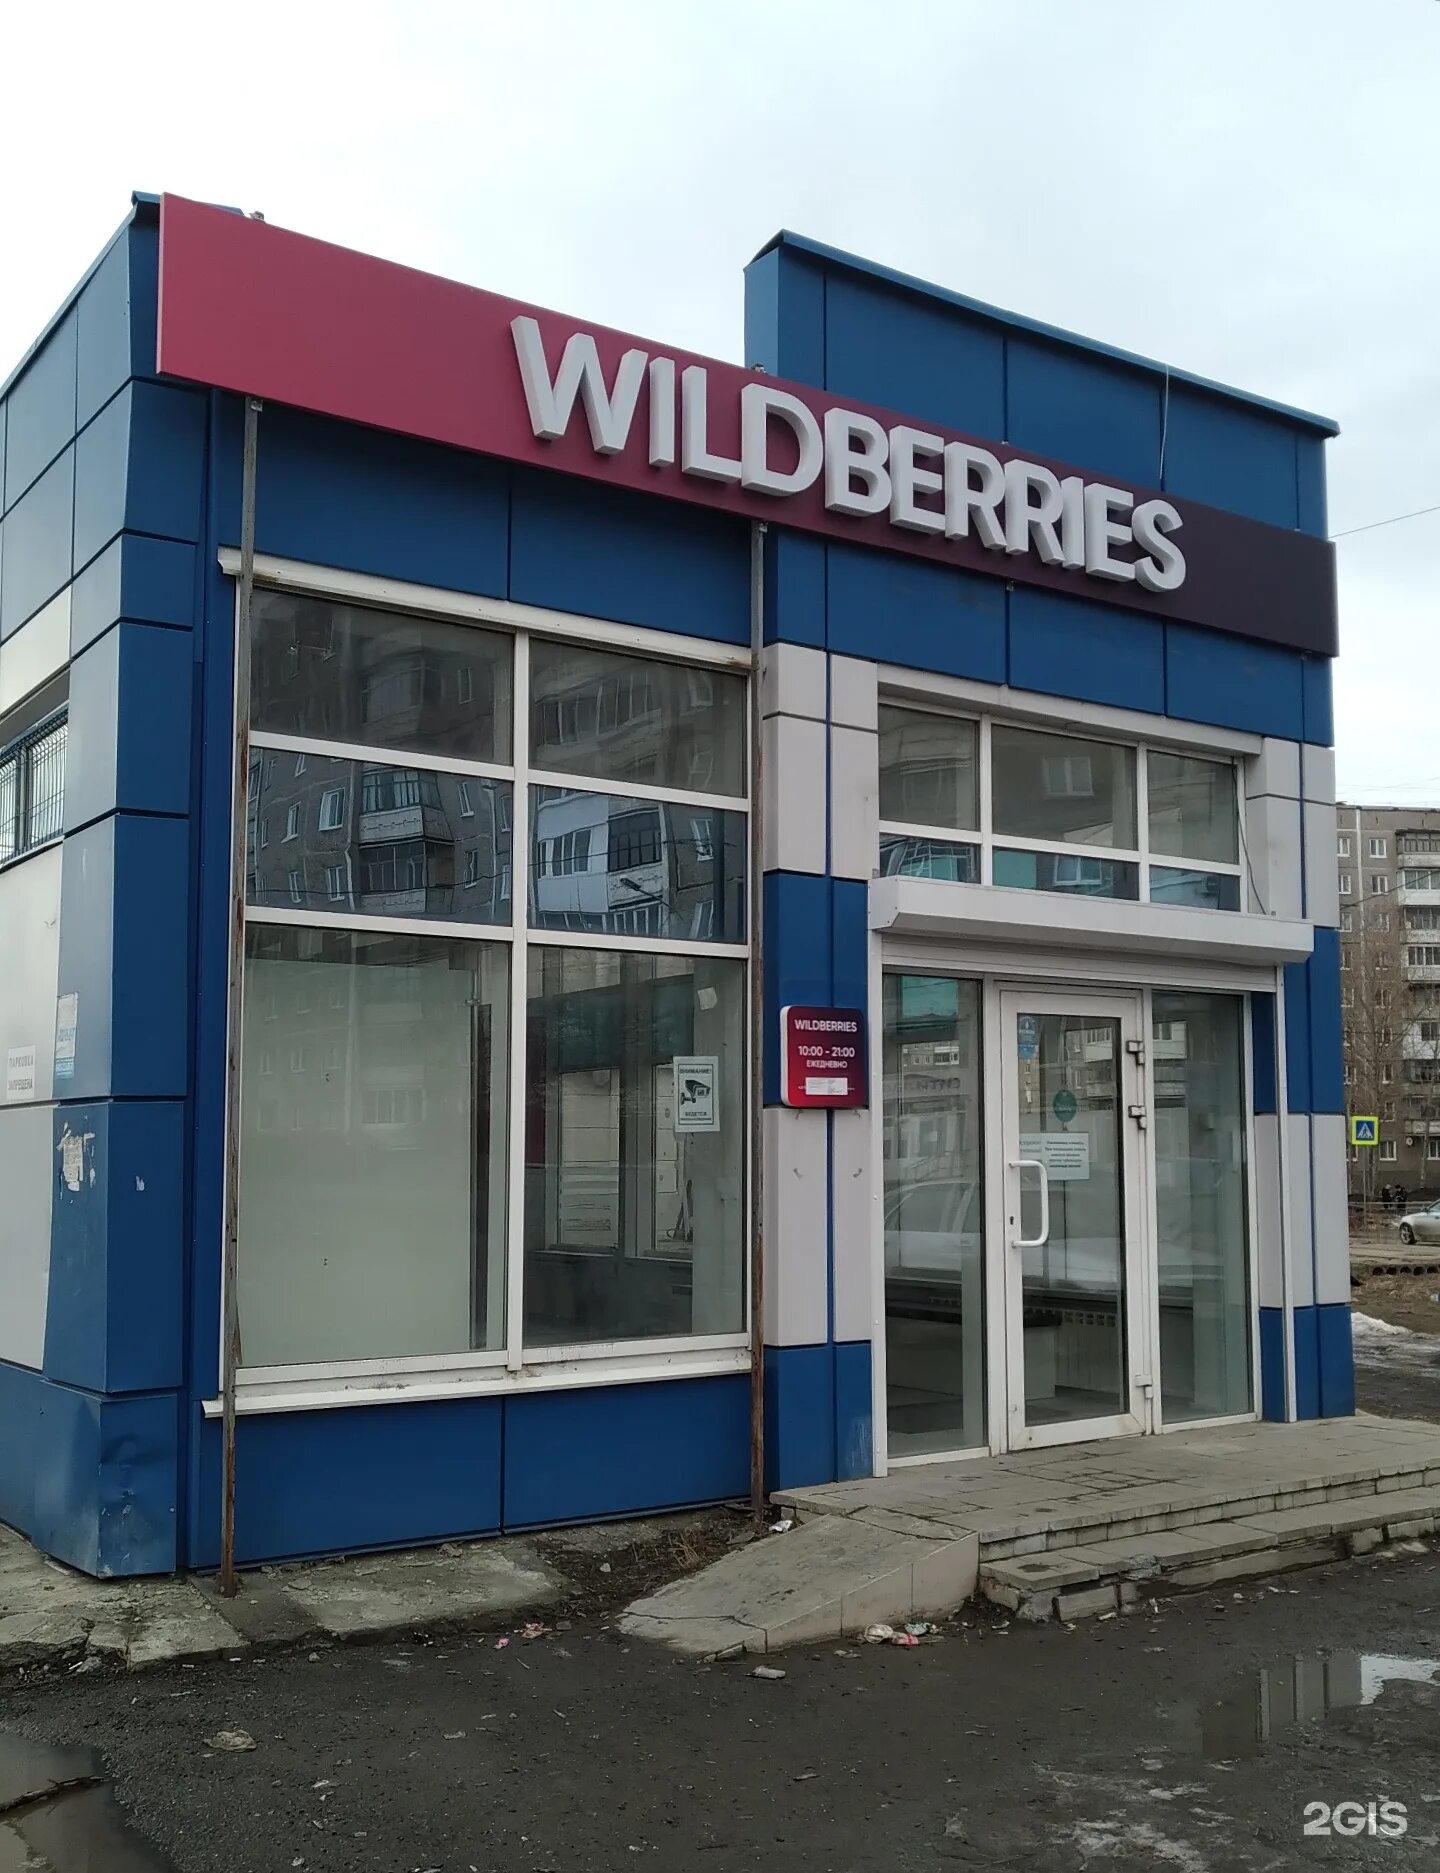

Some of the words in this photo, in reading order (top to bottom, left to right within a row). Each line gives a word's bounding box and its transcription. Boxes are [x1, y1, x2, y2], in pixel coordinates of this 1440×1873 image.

[510, 315, 1188, 593] WILDBERRIES
[794, 1019, 858, 1033] WILDBERRIES
[798, 1045, 823, 1056] 10:00
[831, 1046, 855, 1058] 21:00
[806, 1060, 848, 1069] ЕЖЕДНЕВНО
